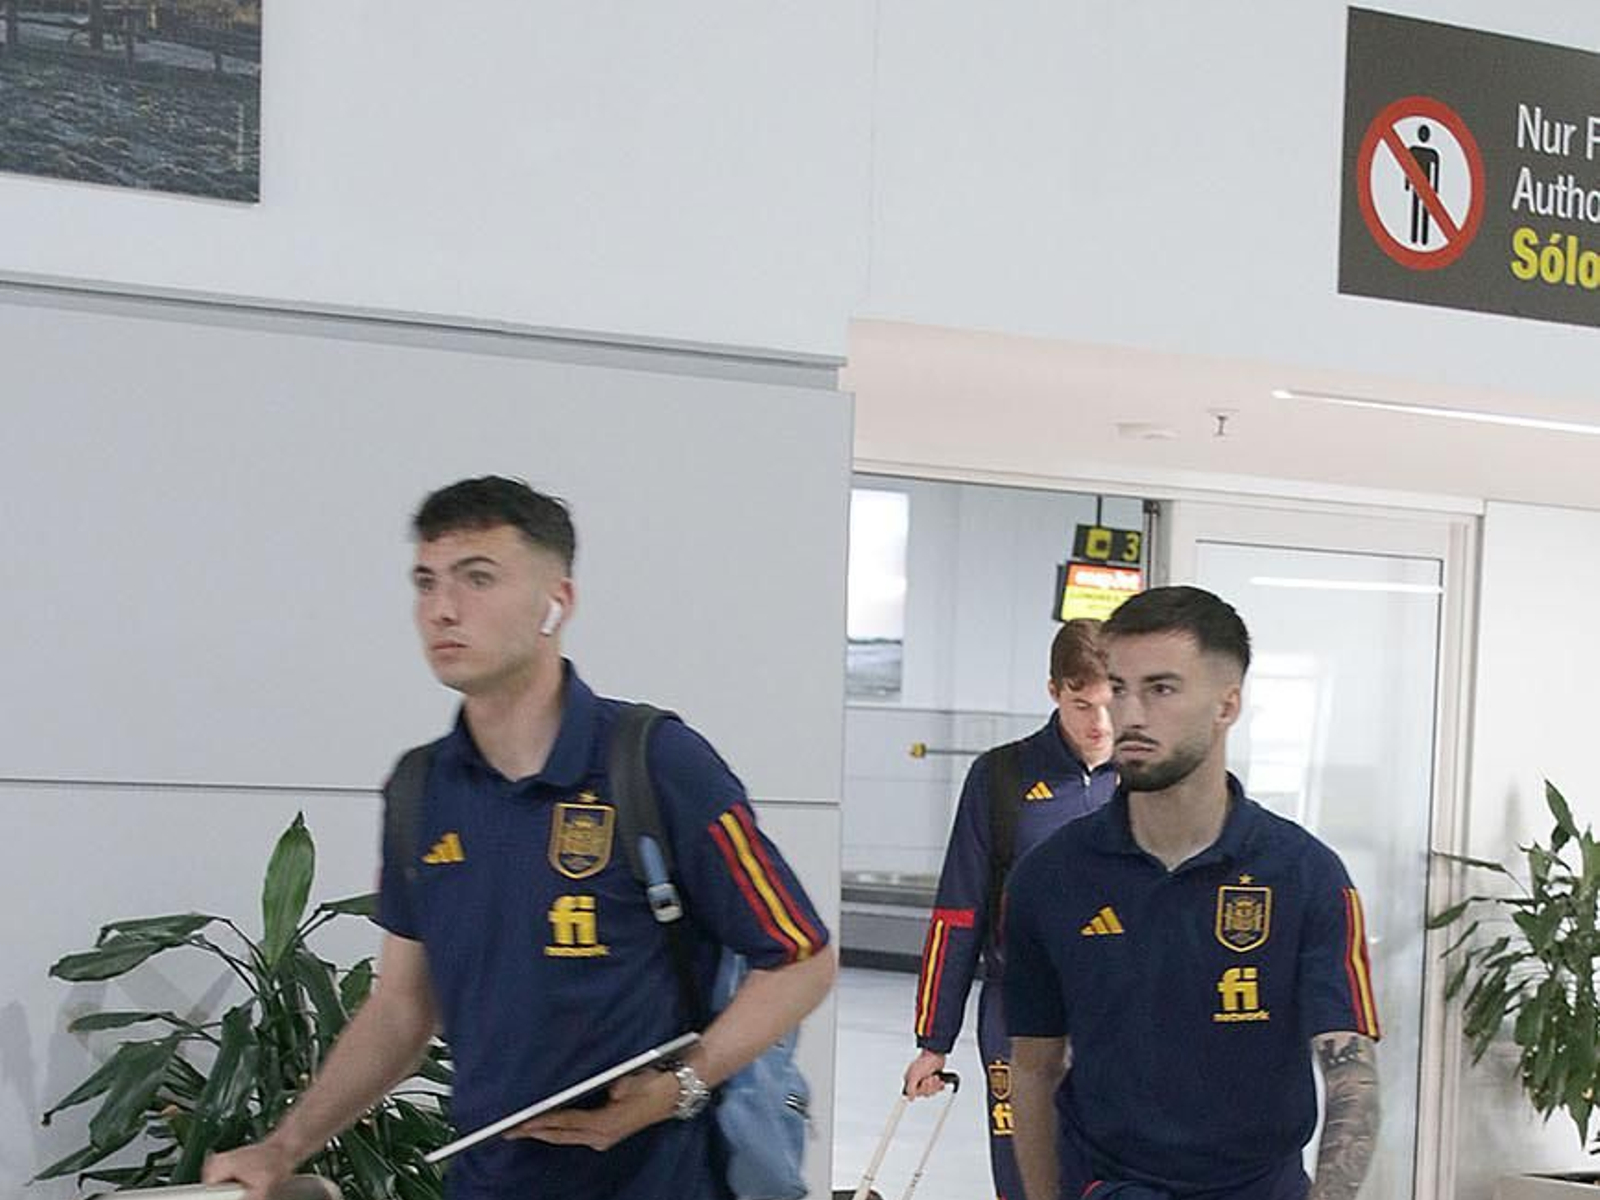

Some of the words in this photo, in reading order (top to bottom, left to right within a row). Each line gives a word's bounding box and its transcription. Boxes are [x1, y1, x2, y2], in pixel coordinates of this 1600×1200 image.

[1517, 103, 1578, 157] Nur
[1511, 166, 1600, 224] Autho
[1511, 227, 1600, 289] Sólo
[1122, 532, 1140, 561] 3
[1217, 967, 1259, 1010] fi
